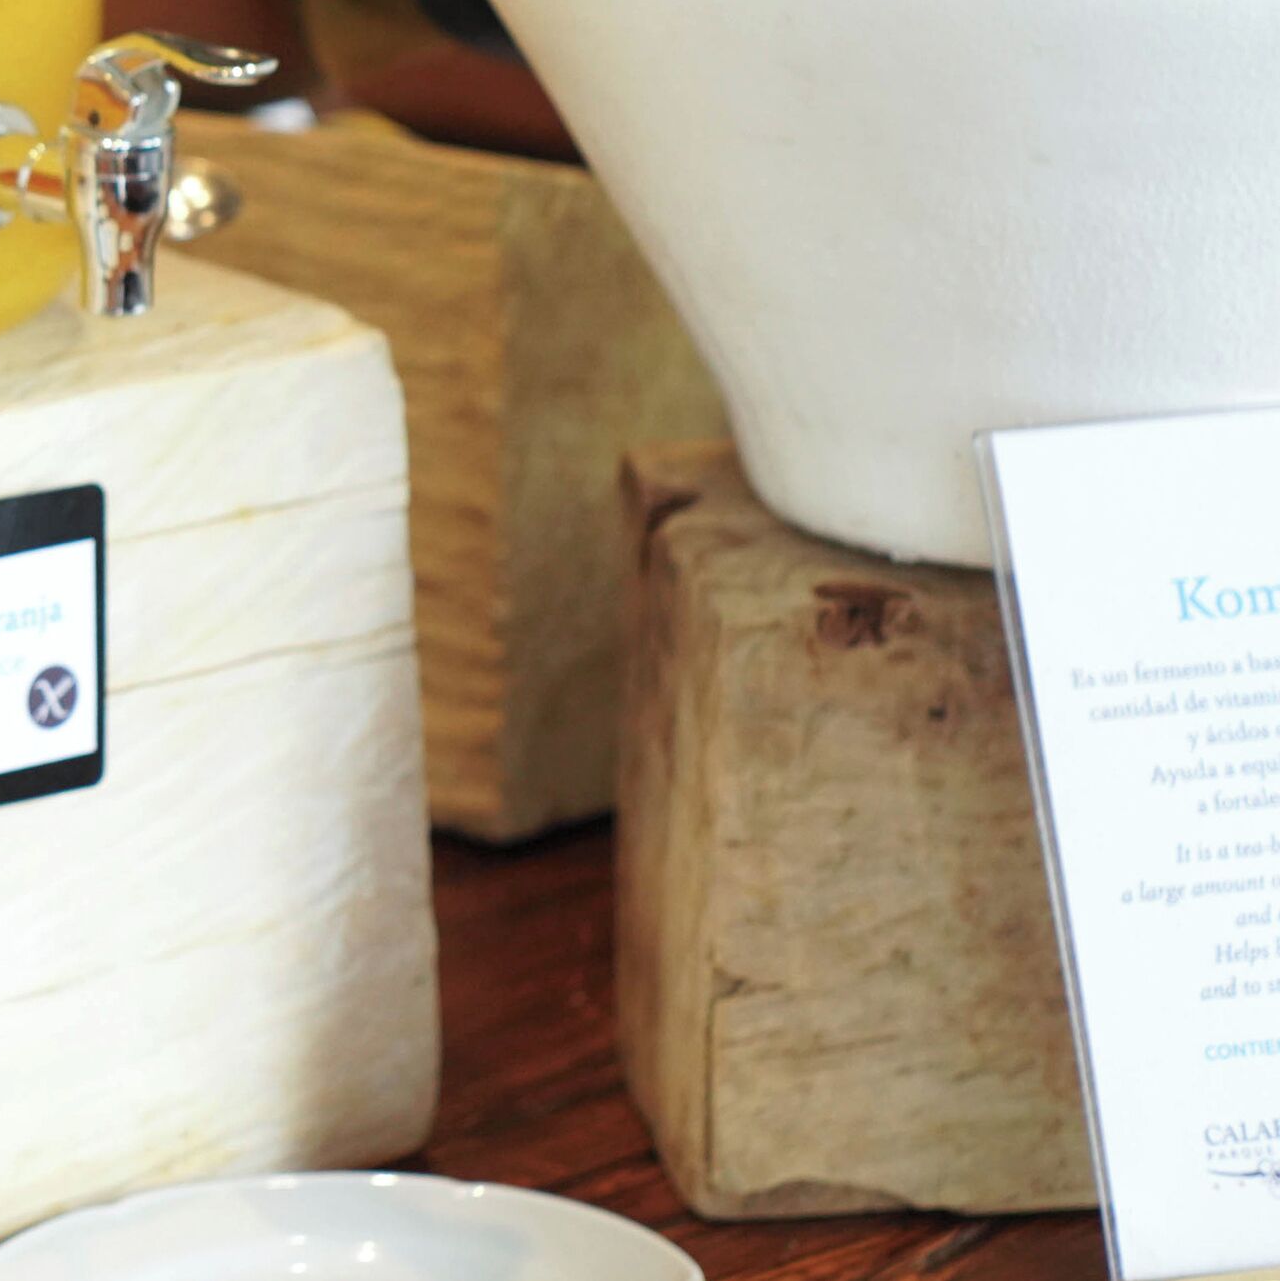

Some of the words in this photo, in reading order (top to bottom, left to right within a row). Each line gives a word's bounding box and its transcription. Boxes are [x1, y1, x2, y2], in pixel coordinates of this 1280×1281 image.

[1071, 667, 1096, 690] Es
[1101, 670, 1128, 687] un
[1133, 657, 1227, 685] fermento
[1088, 690, 1178, 722] cantidad
[1184, 689, 1209, 713] de
[1187, 731, 1199, 752] y
[1206, 718, 1269, 746] ácidos
[1150, 757, 1218, 787] Ayuda
[1197, 799, 1208, 815] a
[1175, 842, 1191, 864] It
[1196, 841, 1212, 862] is
[1217, 845, 1230, 861] a
[1121, 888, 1134, 905] a
[1138, 880, 1187, 907] large
[1191, 874, 1265, 898] amount
[1235, 903, 1272, 927] and
[1215, 939, 1270, 967] Helps
[1200, 975, 1237, 1002] and
[1243, 979, 1262, 997] to
[1204, 1038, 1280, 1061] CONTIE
